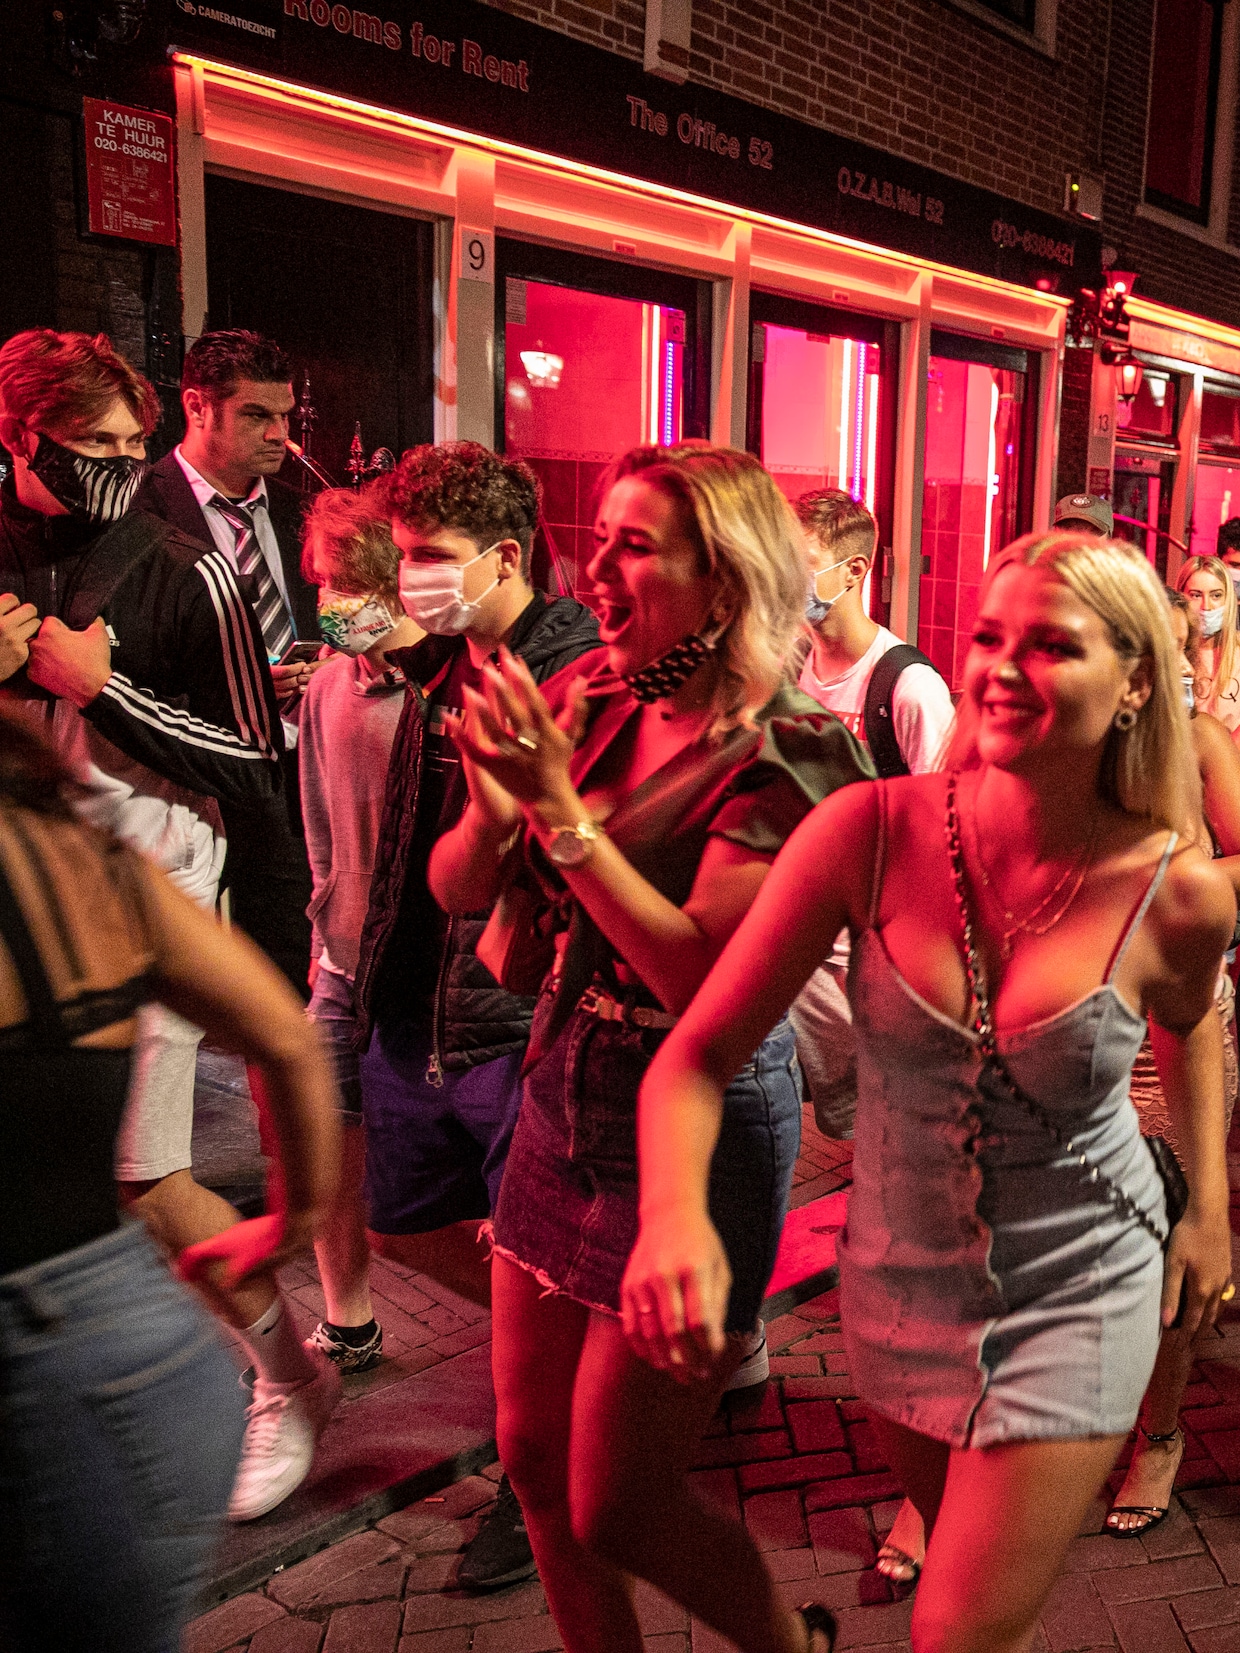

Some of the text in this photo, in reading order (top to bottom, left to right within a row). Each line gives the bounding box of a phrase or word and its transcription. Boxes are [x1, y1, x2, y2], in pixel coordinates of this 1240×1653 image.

[198, 5, 277, 40] CAMERATOEZICHT
[410, 21, 456, 67] for
[462, 38, 529, 93] Rent
[95, 121, 166, 149] TE HUUR
[103, 109, 157, 134] KAMER
[626, 94, 774, 170] The Office 52
[93, 136, 168, 163] 020-6386421
[468, 239, 485, 271] 9
[1098, 413, 1109, 432] 13
